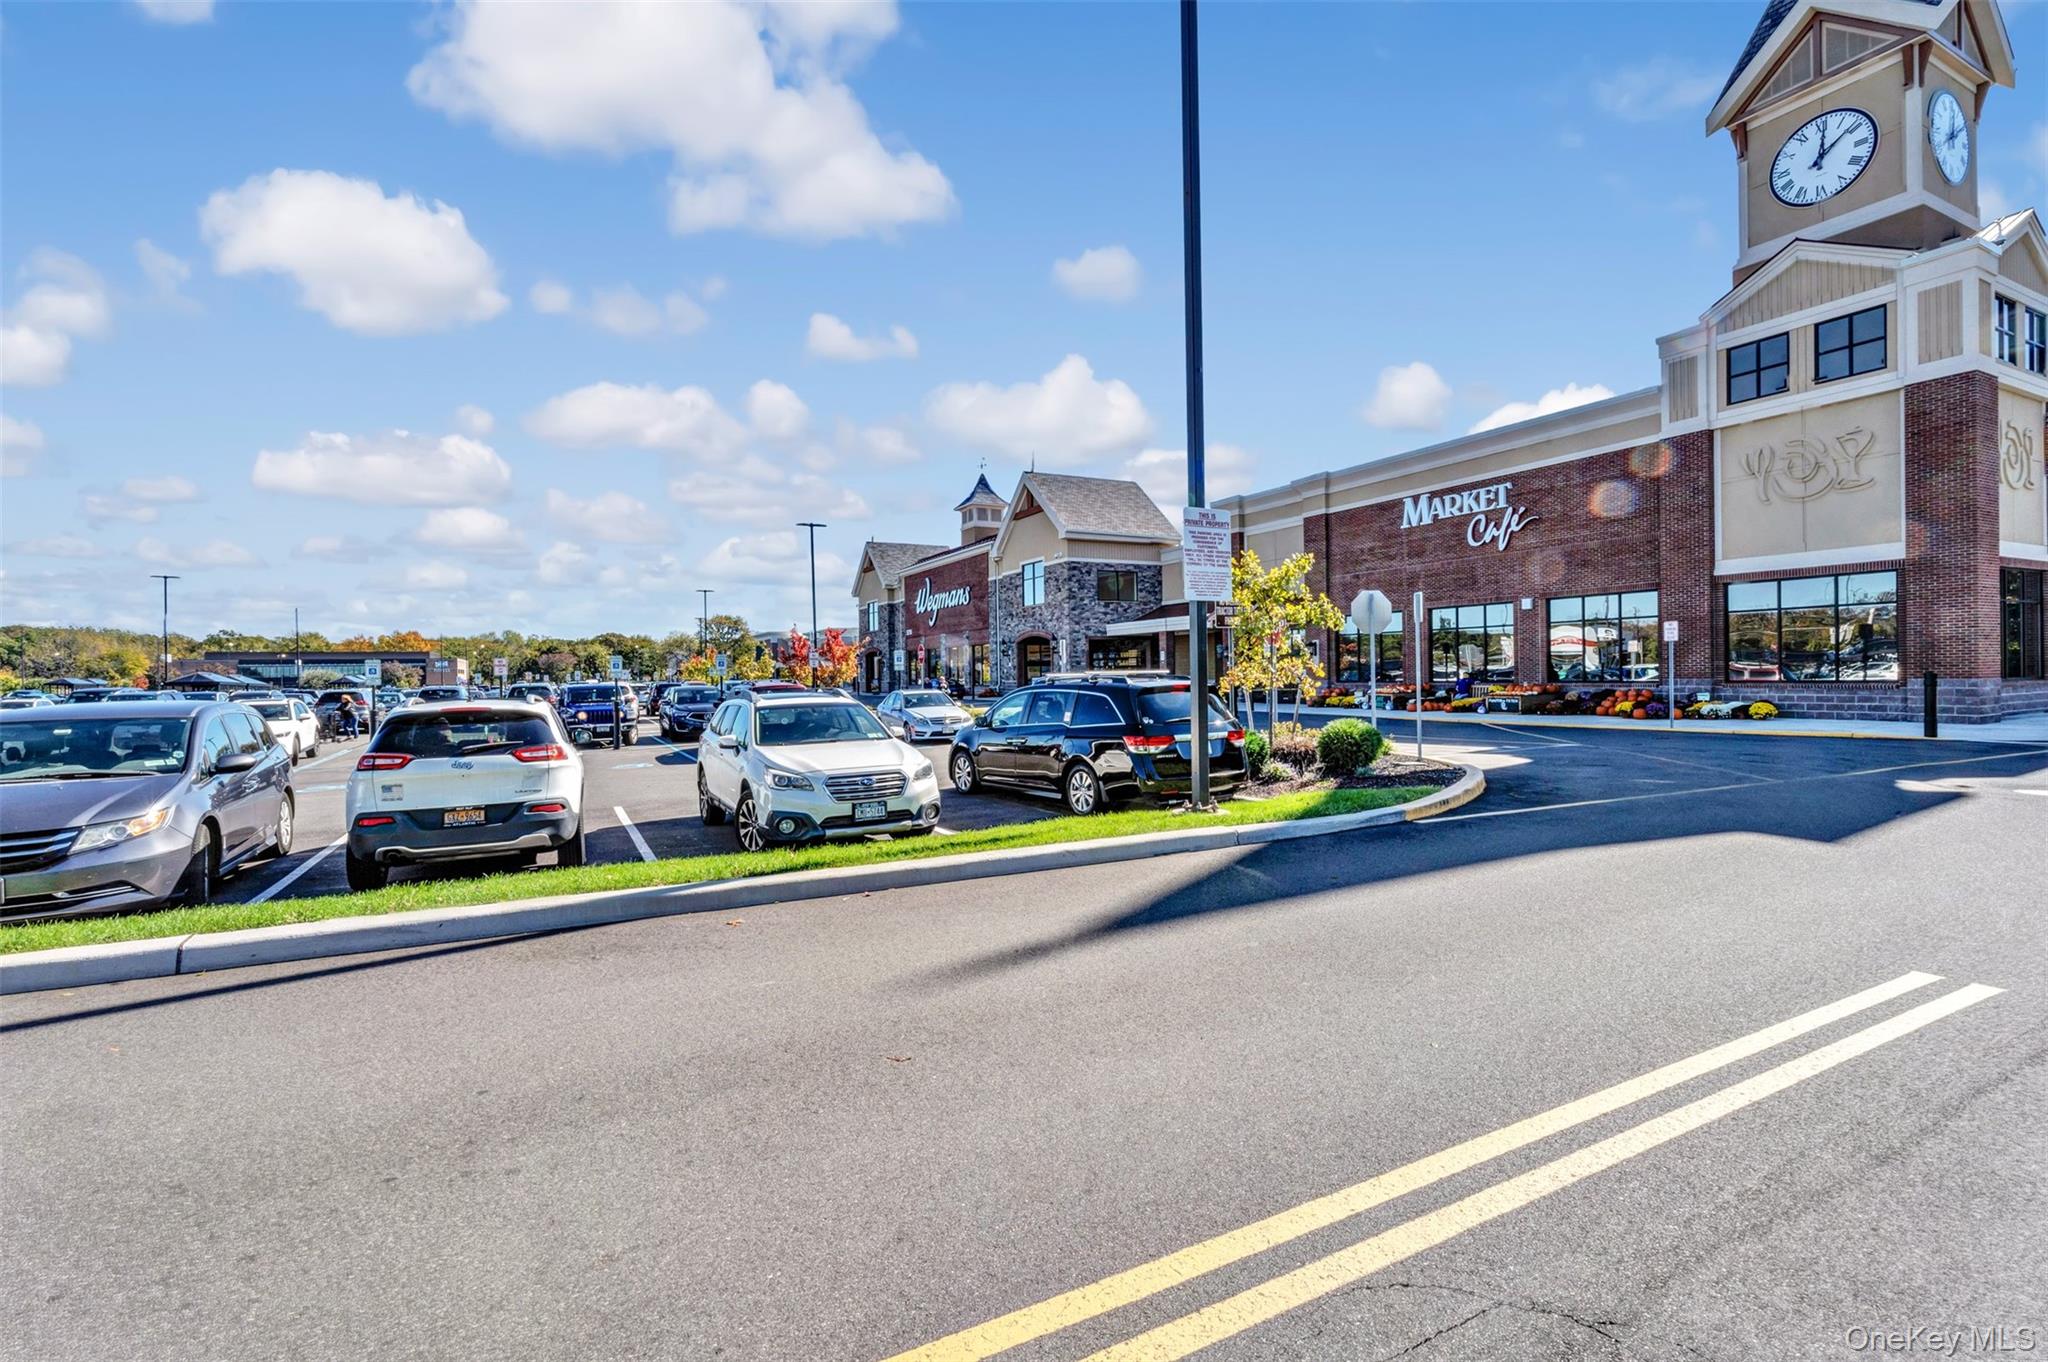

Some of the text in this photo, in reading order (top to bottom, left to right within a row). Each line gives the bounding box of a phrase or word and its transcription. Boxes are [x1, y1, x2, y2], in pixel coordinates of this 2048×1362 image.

[1184, 519, 1230, 528] PRIVATE PROPERTY
[1400, 482, 1513, 529] MARKET
[1466, 506, 1540, 551] Café
[914, 577, 970, 627] Wegmans
